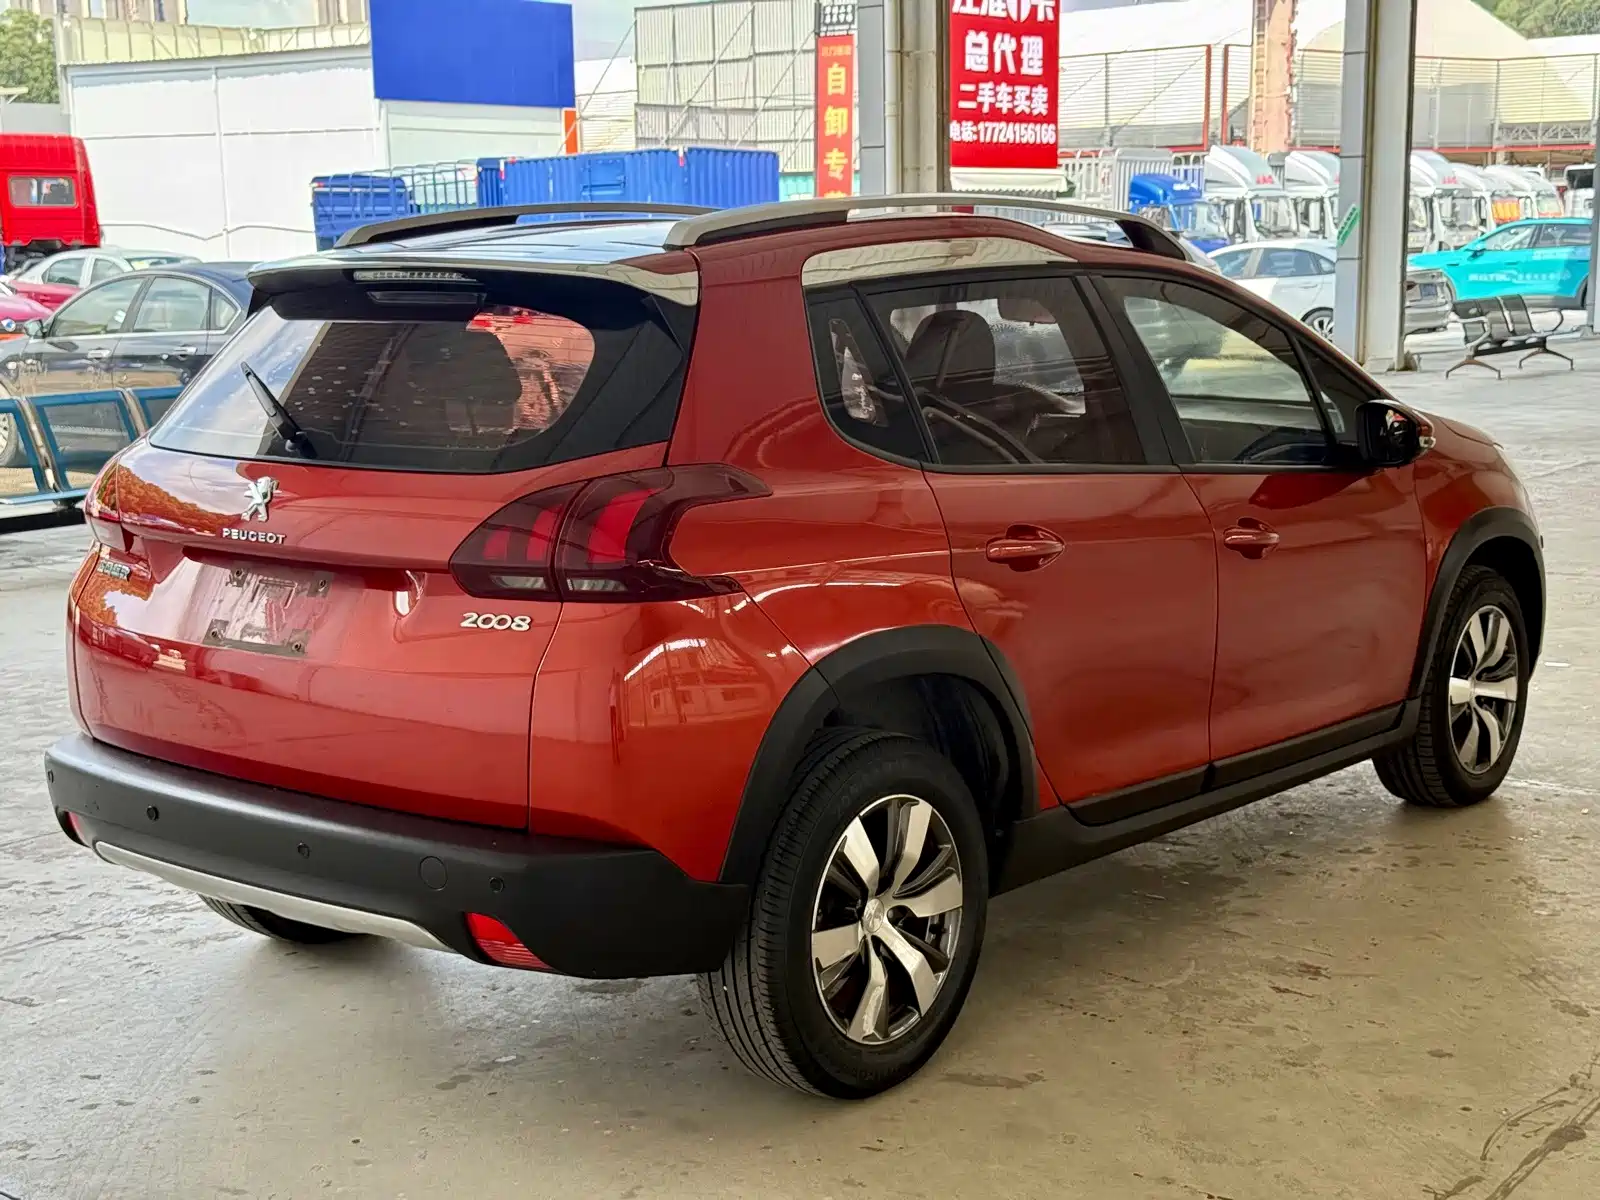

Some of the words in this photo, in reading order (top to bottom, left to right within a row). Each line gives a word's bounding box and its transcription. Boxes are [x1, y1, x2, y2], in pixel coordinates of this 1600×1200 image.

[964, 29, 1044, 76] 总代理
[957, 80, 1048, 116] 二手车买卖
[823, 61, 849, 198] 自卸专
[222, 522, 286, 545] PEUGEOT
[459, 611, 532, 632] 2008
